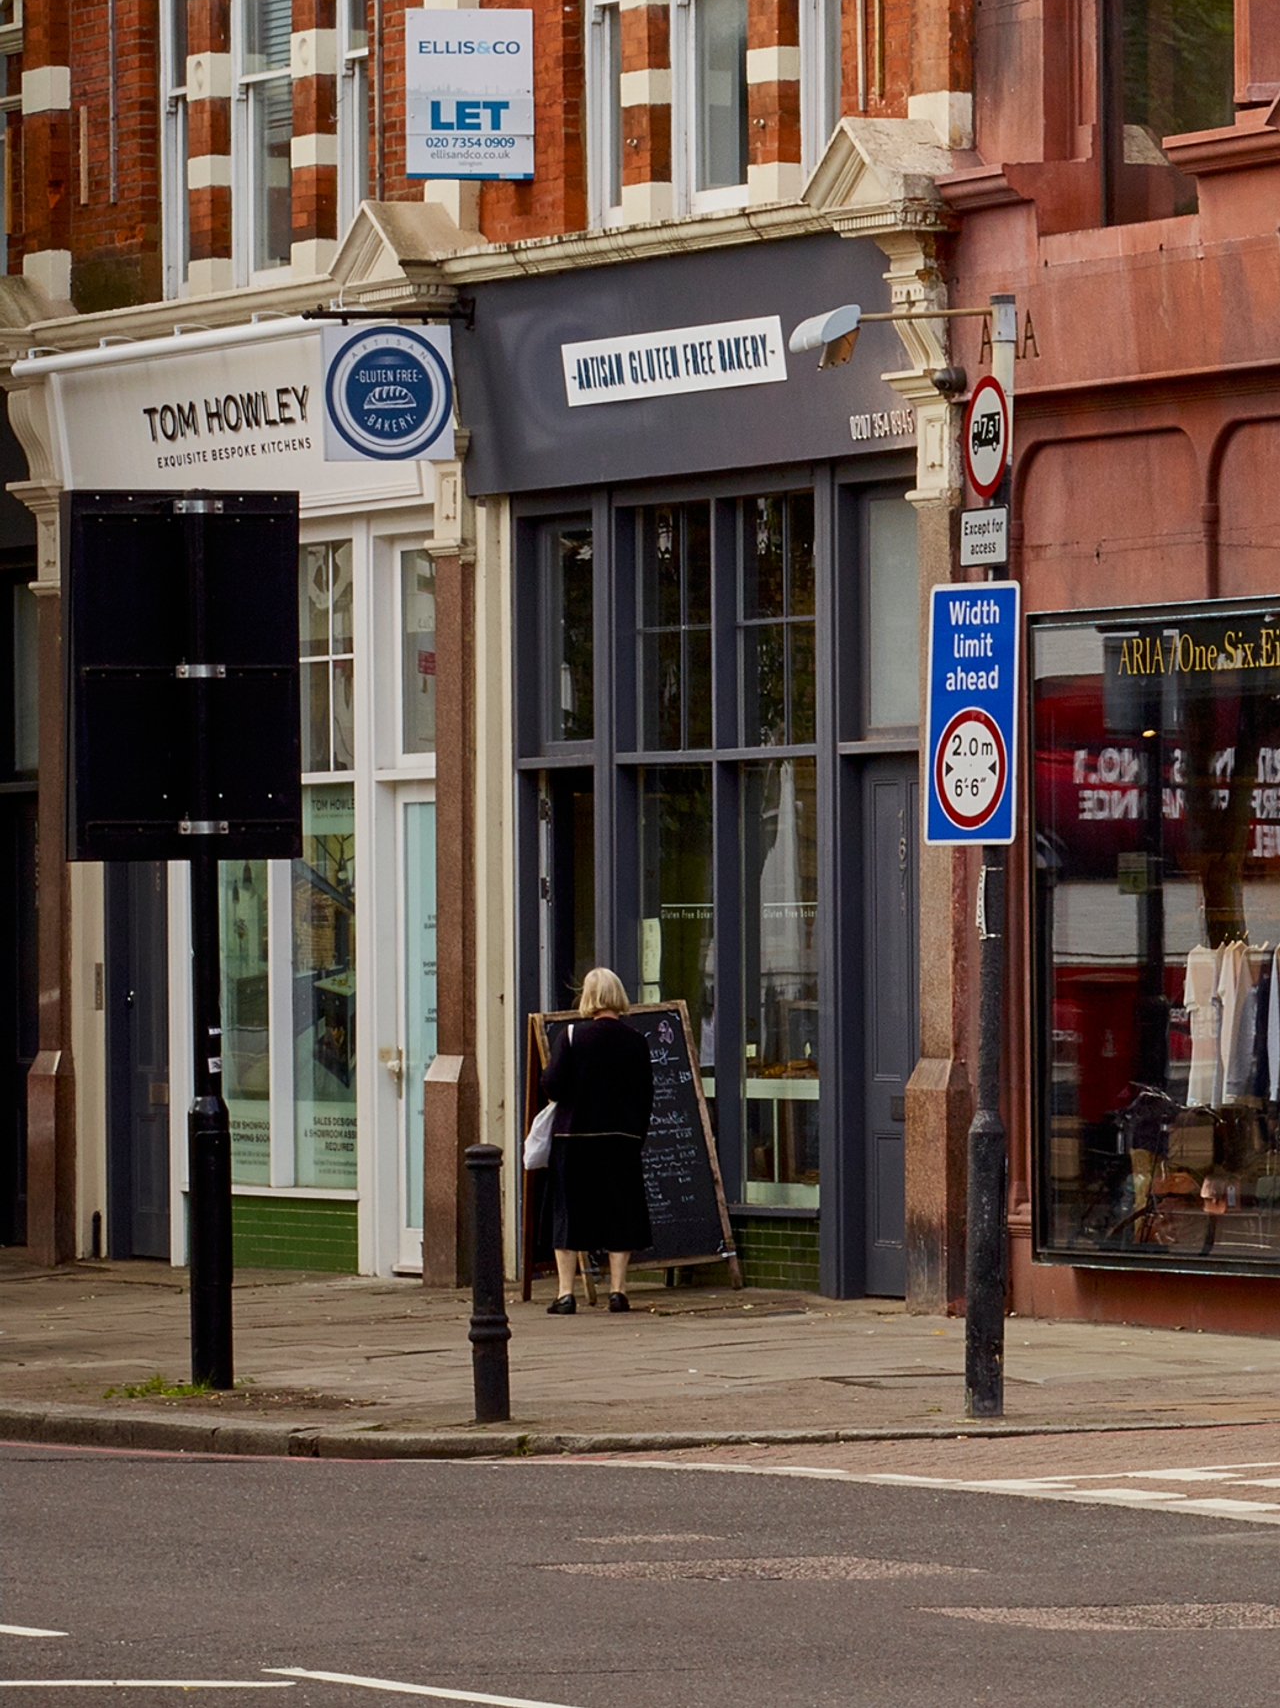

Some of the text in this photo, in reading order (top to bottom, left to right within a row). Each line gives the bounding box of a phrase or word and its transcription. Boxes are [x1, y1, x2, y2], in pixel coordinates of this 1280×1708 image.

[418, 40, 521, 55] ELLIS&CO
[430, 100, 510, 131] LET
[425, 137, 516, 148] 020 7354 0909
[430, 150, 511, 160] ellisandco.co.uk
[350, 338, 428, 360] ARTISAN
[628, 344, 680, 383] GLUTEN
[682, 340, 716, 377] FREE
[142, 384, 311, 444] TOM HOWLEY
[849, 414, 872, 441] 0207
[873, 412, 890, 437] 354
[157, 437, 312, 469] EXQUISITE BESPOKE KITCHENS
[963, 518, 1004, 539] Except for
[970, 541, 997, 555] access
[949, 599, 1000, 626] Width
[953, 633, 993, 659] limit
[1117, 637, 1165, 676] ARIA
[945, 665, 999, 691] ahead
[311, 798, 355, 811] TOM HOWLE
[313, 1116, 332, 1126] SALES
